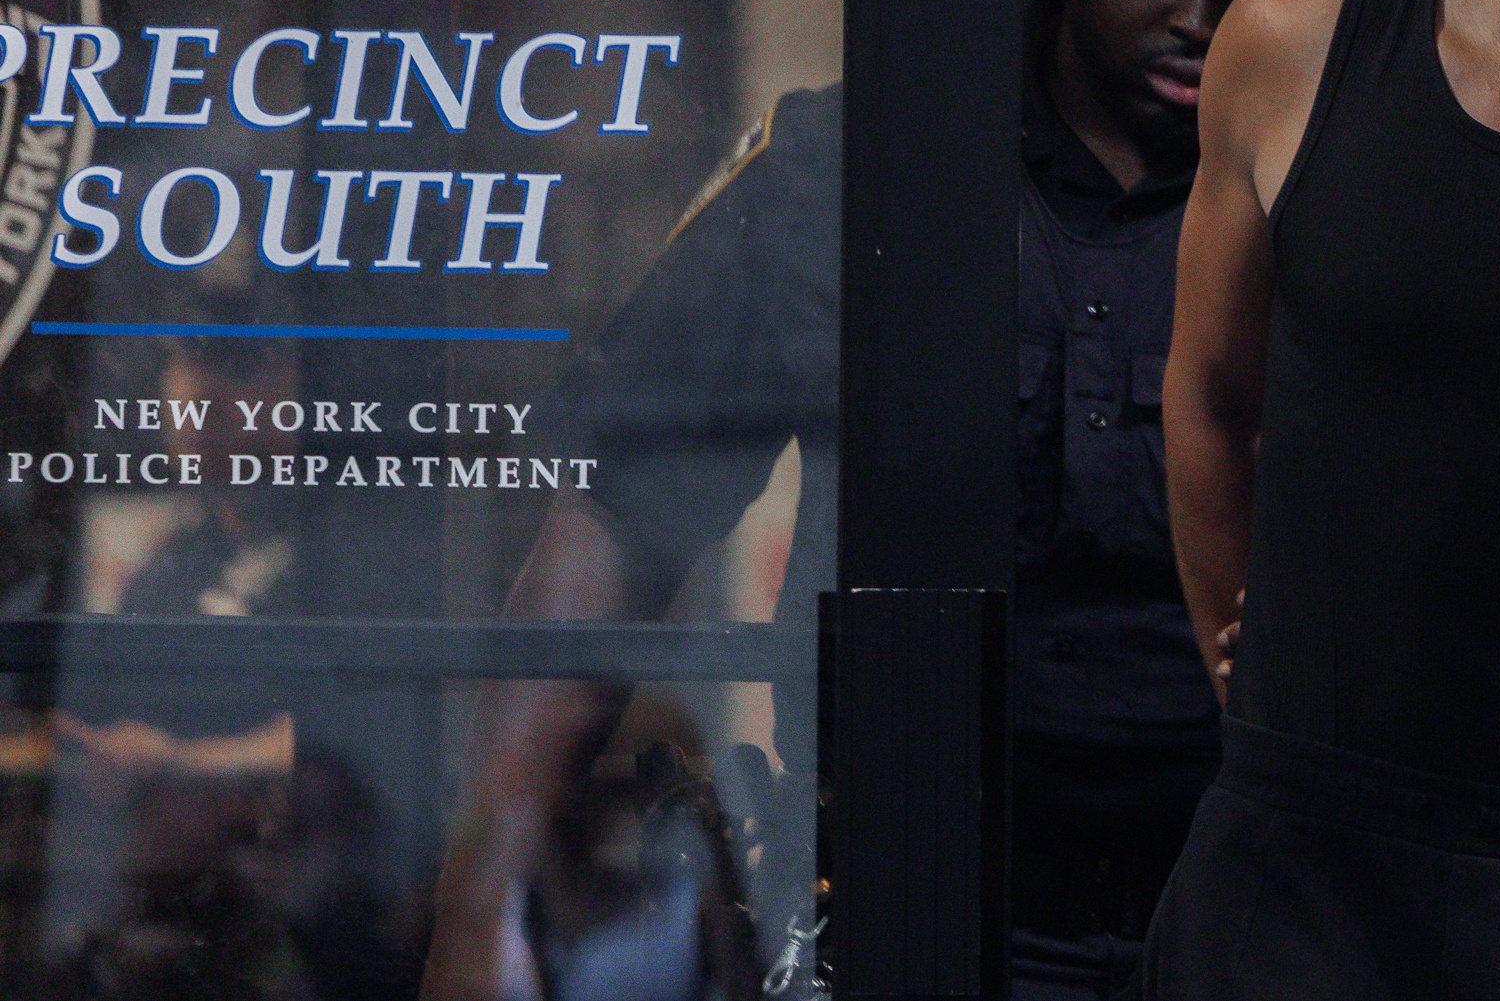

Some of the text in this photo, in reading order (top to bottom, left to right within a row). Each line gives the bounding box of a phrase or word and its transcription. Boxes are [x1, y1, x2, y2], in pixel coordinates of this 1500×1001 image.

[0, 124, 67, 285] ORK
[49, 165, 562, 274] SOUTH
[94, 399, 532, 435] NEW YORK CITY
[8, 451, 598, 490] POLICE DEPARTMENT
